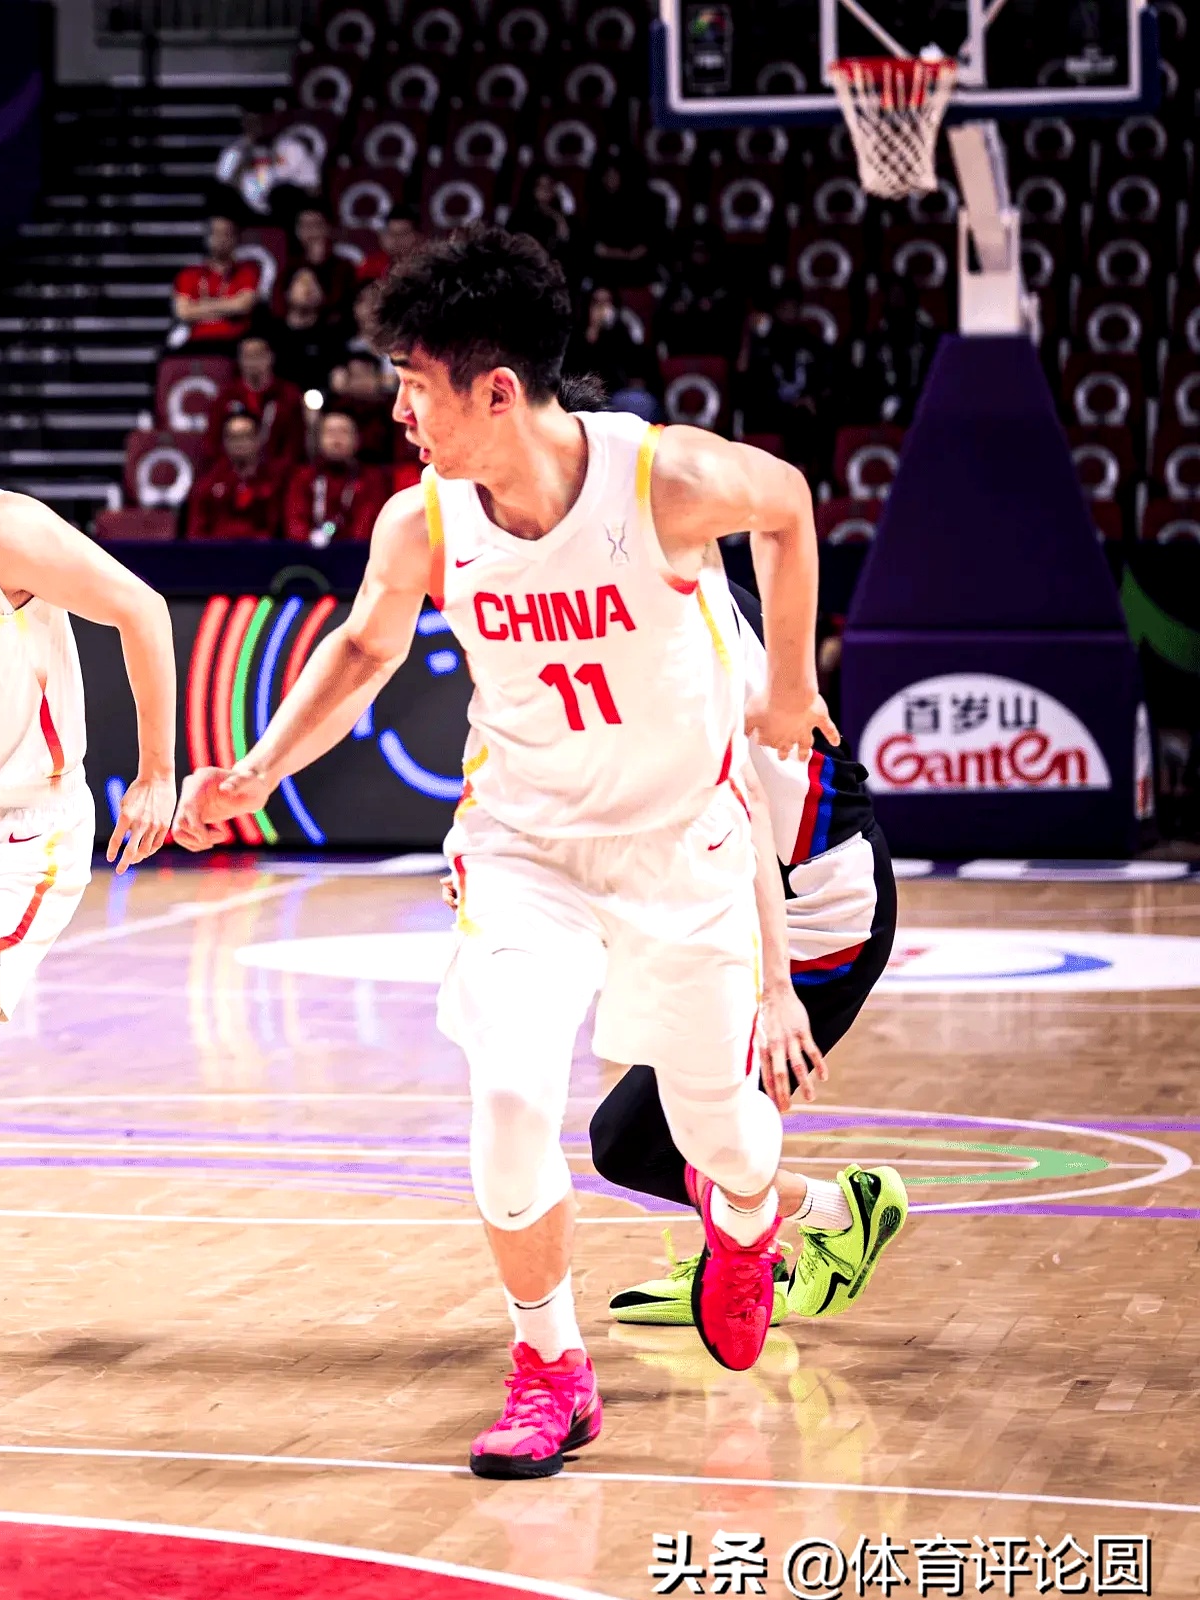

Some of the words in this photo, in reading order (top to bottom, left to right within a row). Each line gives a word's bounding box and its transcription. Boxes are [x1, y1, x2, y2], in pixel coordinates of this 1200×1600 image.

[474, 584, 637, 642] CHINA
[538, 663, 623, 731] 11
[903, 692, 1039, 735] 百岁山
